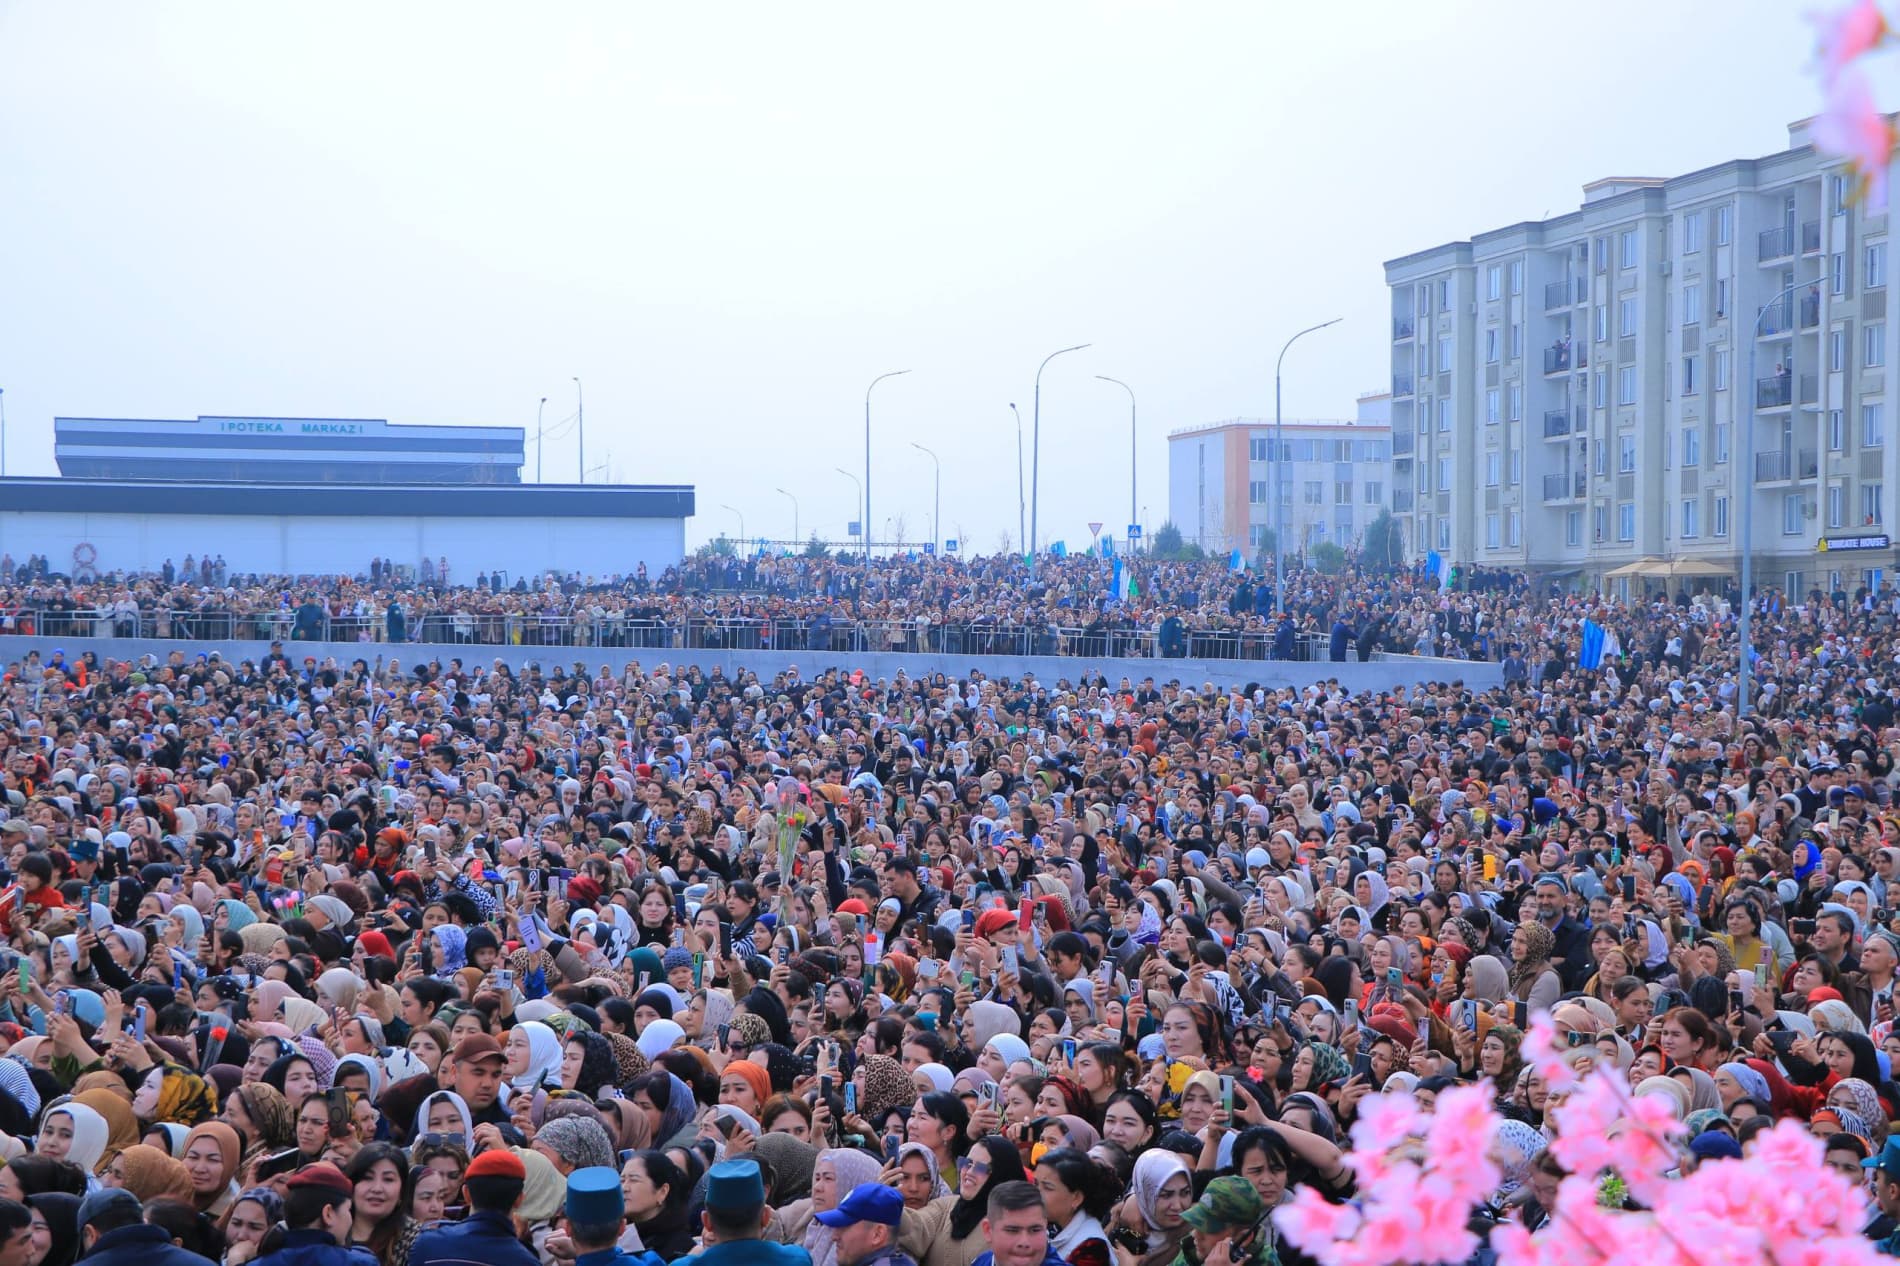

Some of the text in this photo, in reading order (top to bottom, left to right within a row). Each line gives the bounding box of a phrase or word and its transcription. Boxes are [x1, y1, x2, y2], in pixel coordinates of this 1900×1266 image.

[221, 422, 363, 434] IPOTEKA MARKAZI
[1860, 537, 1886, 548] HOUSE
